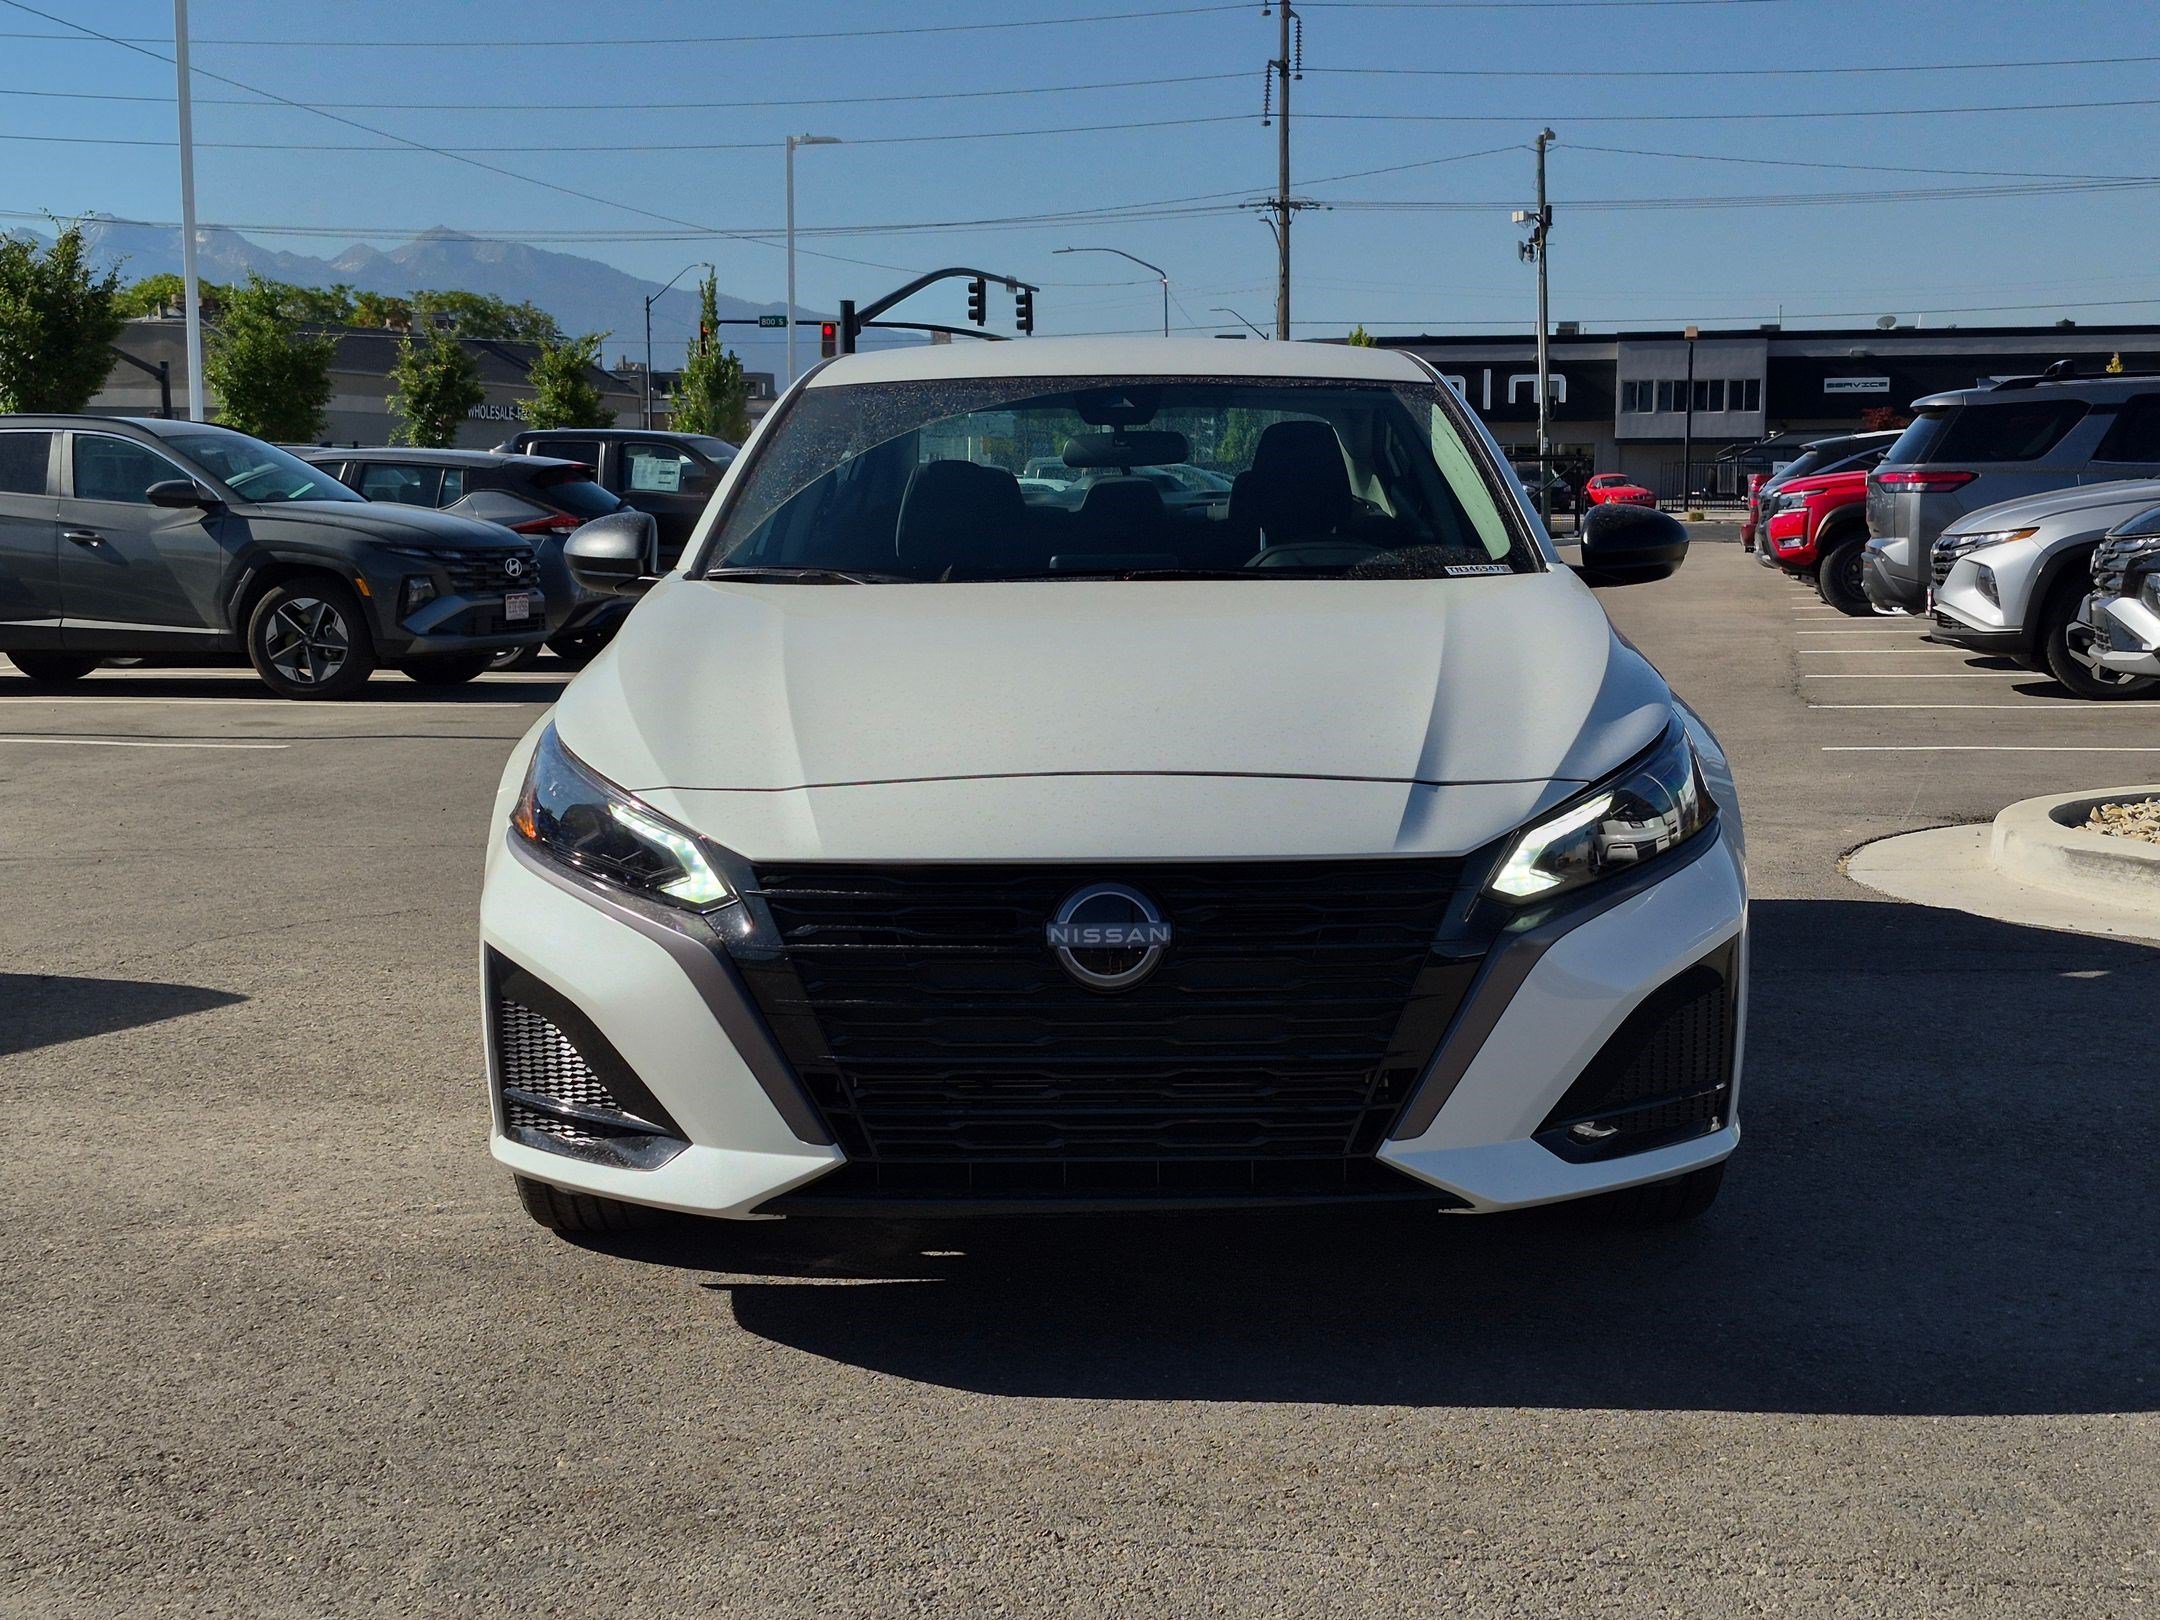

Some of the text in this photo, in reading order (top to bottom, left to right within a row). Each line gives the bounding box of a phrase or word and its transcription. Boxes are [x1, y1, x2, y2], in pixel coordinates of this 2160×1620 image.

[761, 318, 776, 326] 800
[1826, 381, 1888, 389] SERVICE
[1050, 926, 1168, 944] NISSAN
